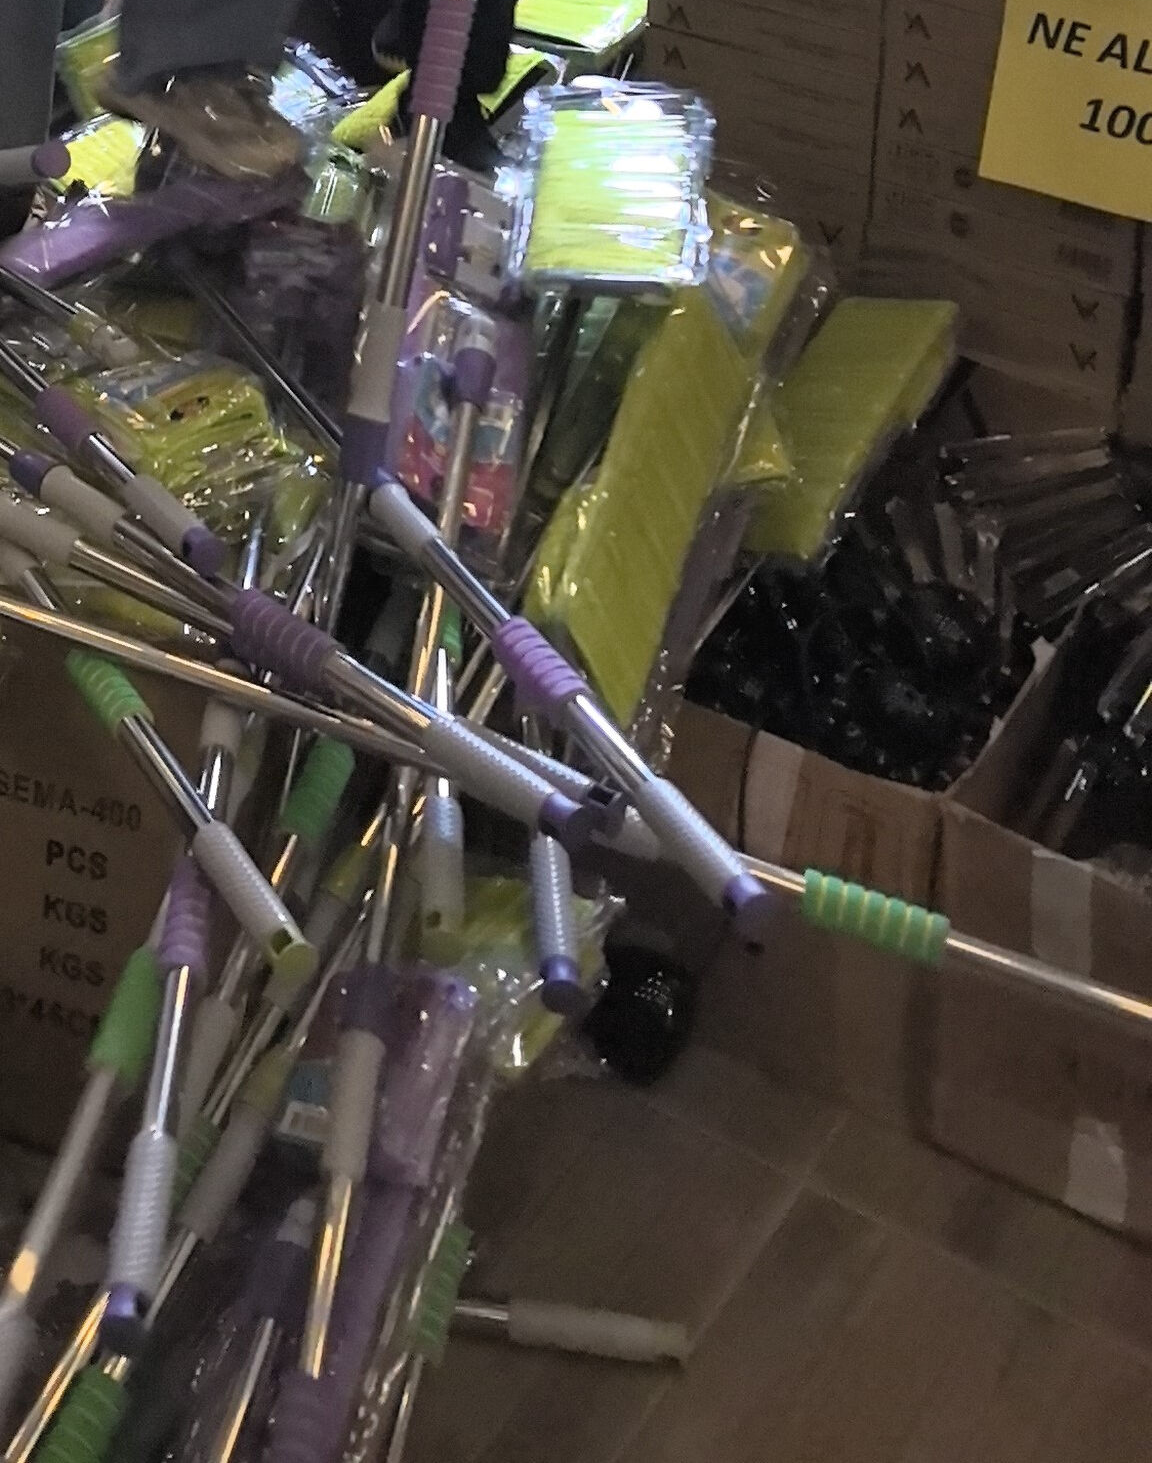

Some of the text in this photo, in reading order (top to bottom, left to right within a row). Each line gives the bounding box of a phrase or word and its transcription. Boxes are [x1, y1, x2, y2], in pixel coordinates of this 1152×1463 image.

[1027, 12, 1092, 57] NE
[47, 840, 108, 881] PCS
[43, 893, 108, 935] KGS
[39, 945, 104, 986] KGS
